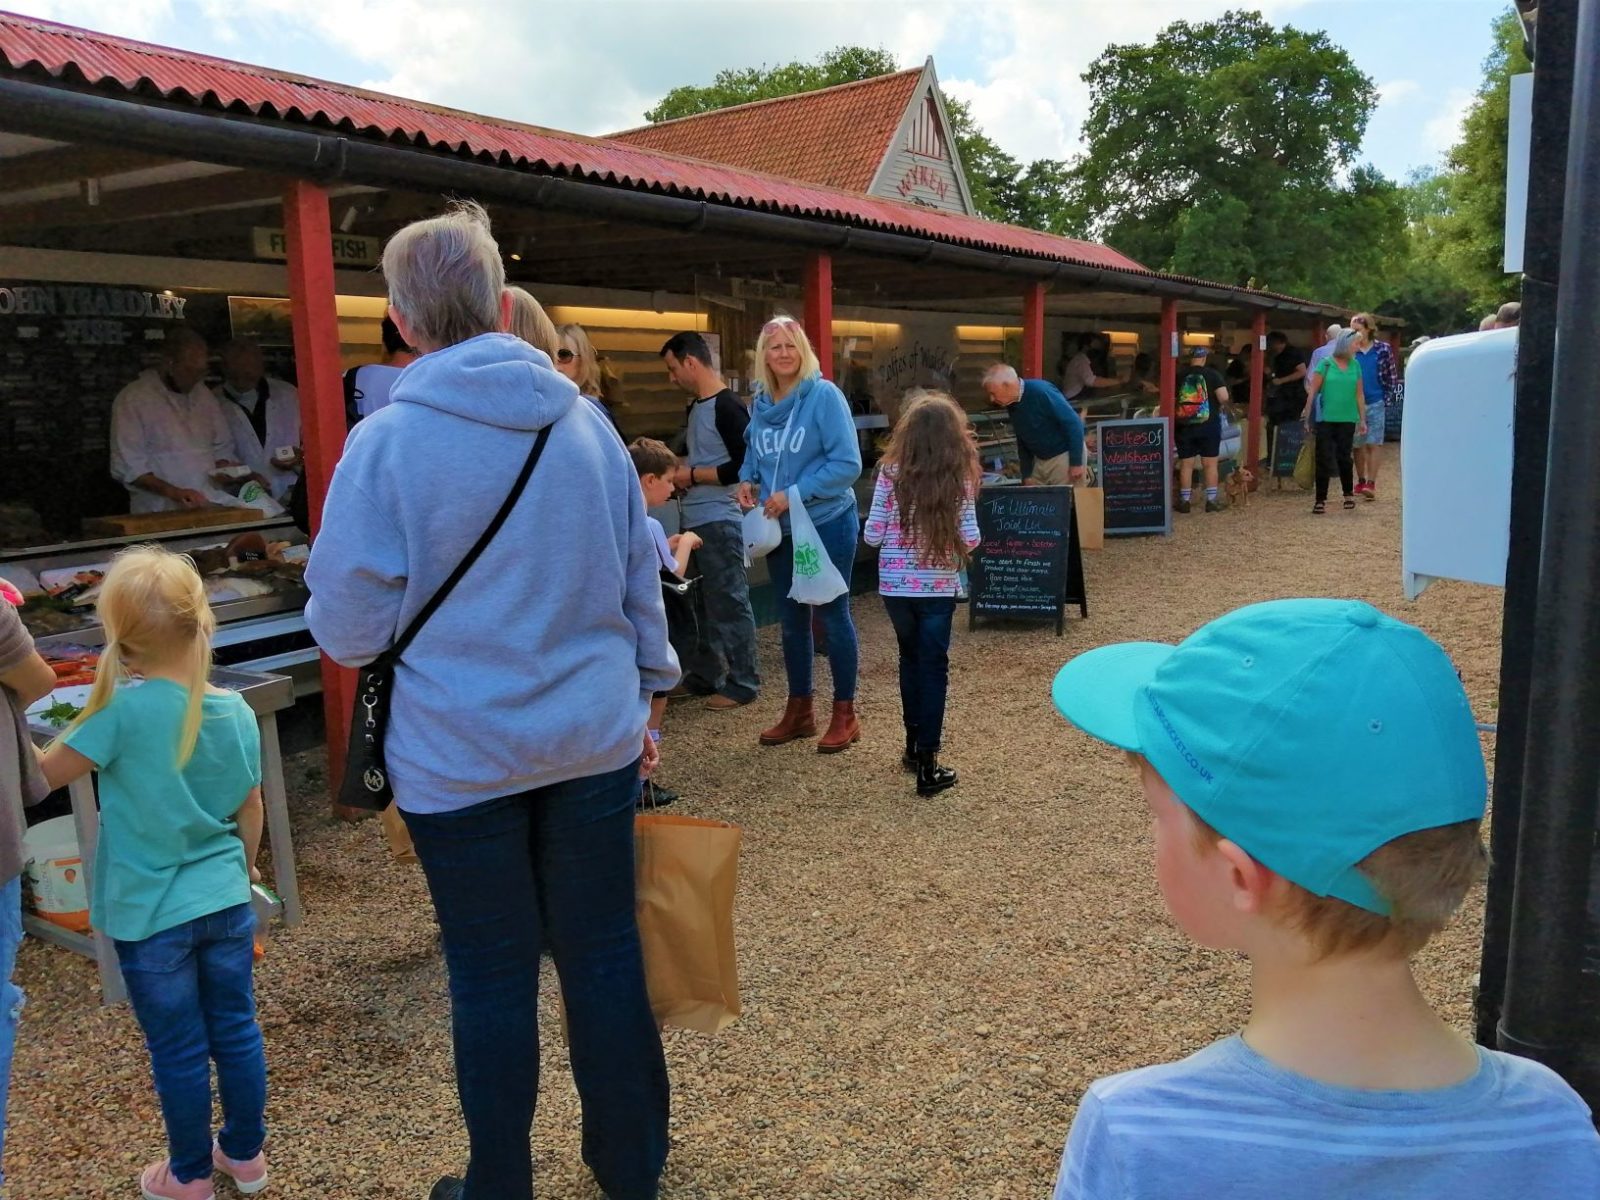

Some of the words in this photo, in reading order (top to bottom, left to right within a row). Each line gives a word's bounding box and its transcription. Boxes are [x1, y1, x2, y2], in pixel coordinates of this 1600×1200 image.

[333, 239, 367, 258] FISH
[0, 287, 56, 314] OHN
[984, 496, 1008, 516] The
